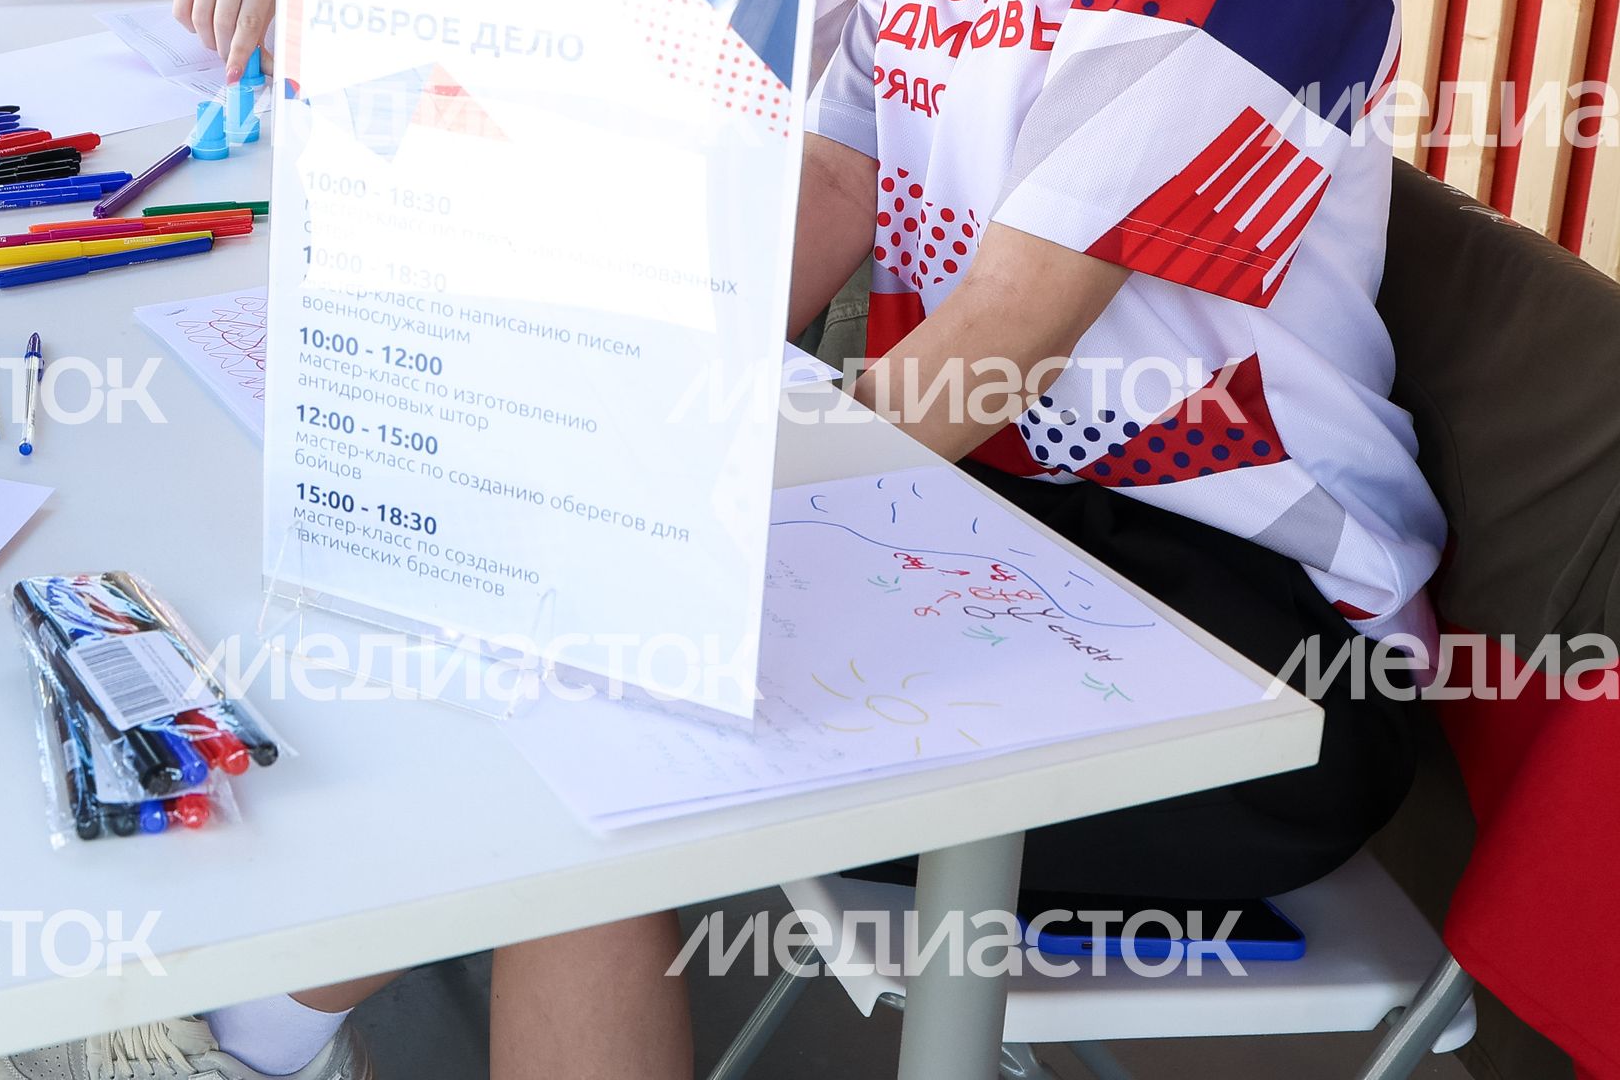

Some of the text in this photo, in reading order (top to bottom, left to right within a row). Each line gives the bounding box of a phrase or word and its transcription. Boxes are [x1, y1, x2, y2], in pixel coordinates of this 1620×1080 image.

[310, 0, 584, 62] ДОБРОЕ ДЕЛО
[306, 170, 367, 199] 10:00
[389, 186, 452, 216] 18:30
[302, 245, 363, 274] 10:00
[386, 262, 447, 293] 18:30
[302, 295, 470, 344] военнослужащим
[431, 301, 454, 317] по
[459, 306, 570, 342] написанию
[577, 332, 641, 359] писем
[299, 327, 359, 356] 10:00
[382, 346, 443, 376] 12:00
[298, 372, 489, 432] антидроновых штор
[299, 352, 597, 433] мастер-класс по изготовлению
[296, 404, 355, 434] 12:00
[377, 425, 438, 455] 15:00
[294, 448, 362, 480] бойцов
[295, 432, 690, 543] мастер-класс по созданию оберегов для
[296, 482, 355, 513] 15:00
[377, 504, 437, 535] 18:30
[293, 506, 540, 585] мастер-класс по созданию
[295, 527, 505, 597] тактических браслетов
